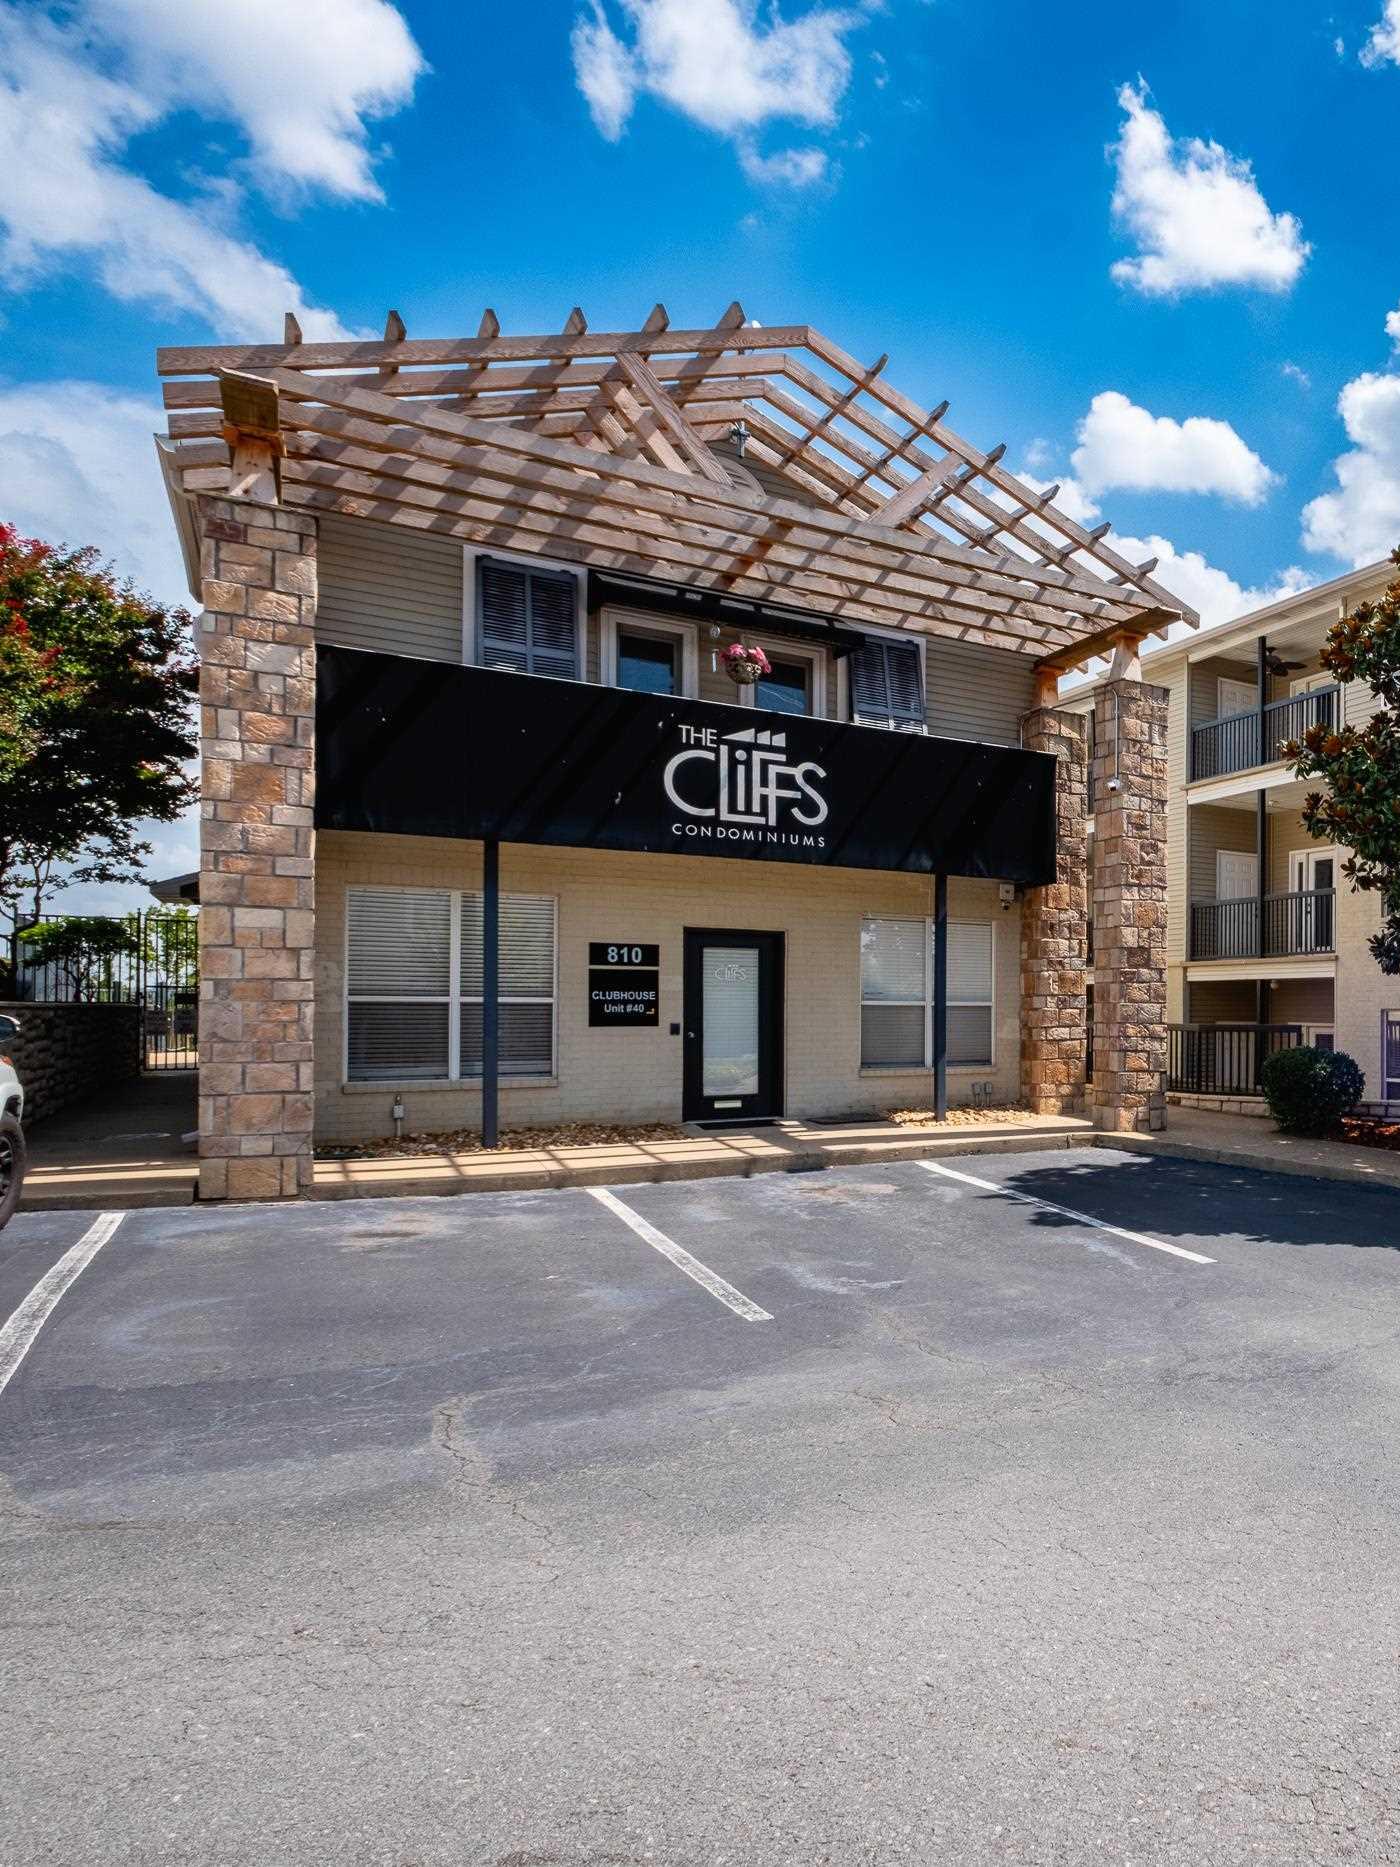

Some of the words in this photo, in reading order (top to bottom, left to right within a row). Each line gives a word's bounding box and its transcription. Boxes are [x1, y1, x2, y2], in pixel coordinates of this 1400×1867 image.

[678, 725, 717, 747] THE
[672, 824, 825, 847] CONDOMINIUMS
[607, 946, 642, 963] 810
[592, 990, 656, 1000] CLUBHOUSE
[604, 1003, 624, 1013] Unit
[626, 1003, 644, 1013] #40
